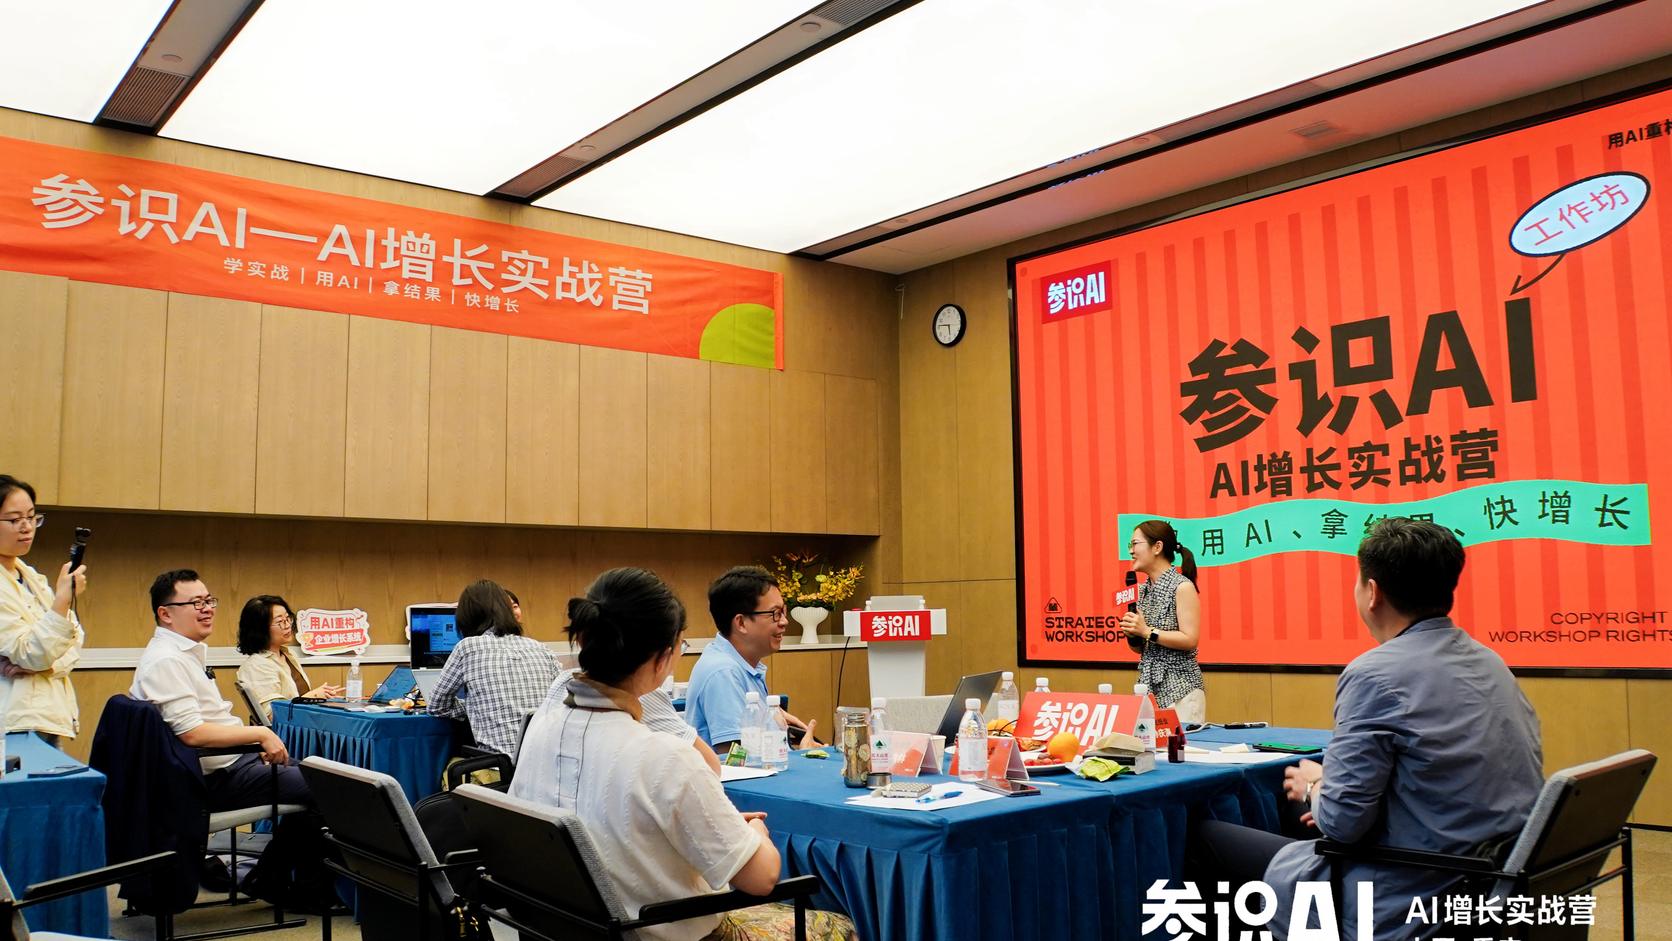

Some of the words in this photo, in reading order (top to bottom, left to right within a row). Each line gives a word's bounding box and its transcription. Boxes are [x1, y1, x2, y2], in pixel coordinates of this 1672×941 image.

[1524, 184, 1629, 246] 工作坊
[223, 257, 289, 281] 学实战
[316, 270, 359, 290] 用AI
[383, 280, 441, 302] 拿结果
[464, 291, 520, 313] 快增长
[1047, 271, 1106, 315] 参识AI
[1179, 297, 1538, 453] 参识AI
[1209, 428, 1499, 499] AI增长实战营
[310, 616, 355, 630] 用AI重构
[871, 615, 920, 637] 参识AI
[1045, 630, 1126, 643] WORKSHOP
[1488, 630, 1601, 643] WORKSHOP
[1550, 611, 1668, 625] COPYRIGHT
[1032, 701, 1120, 746] 参识AI
